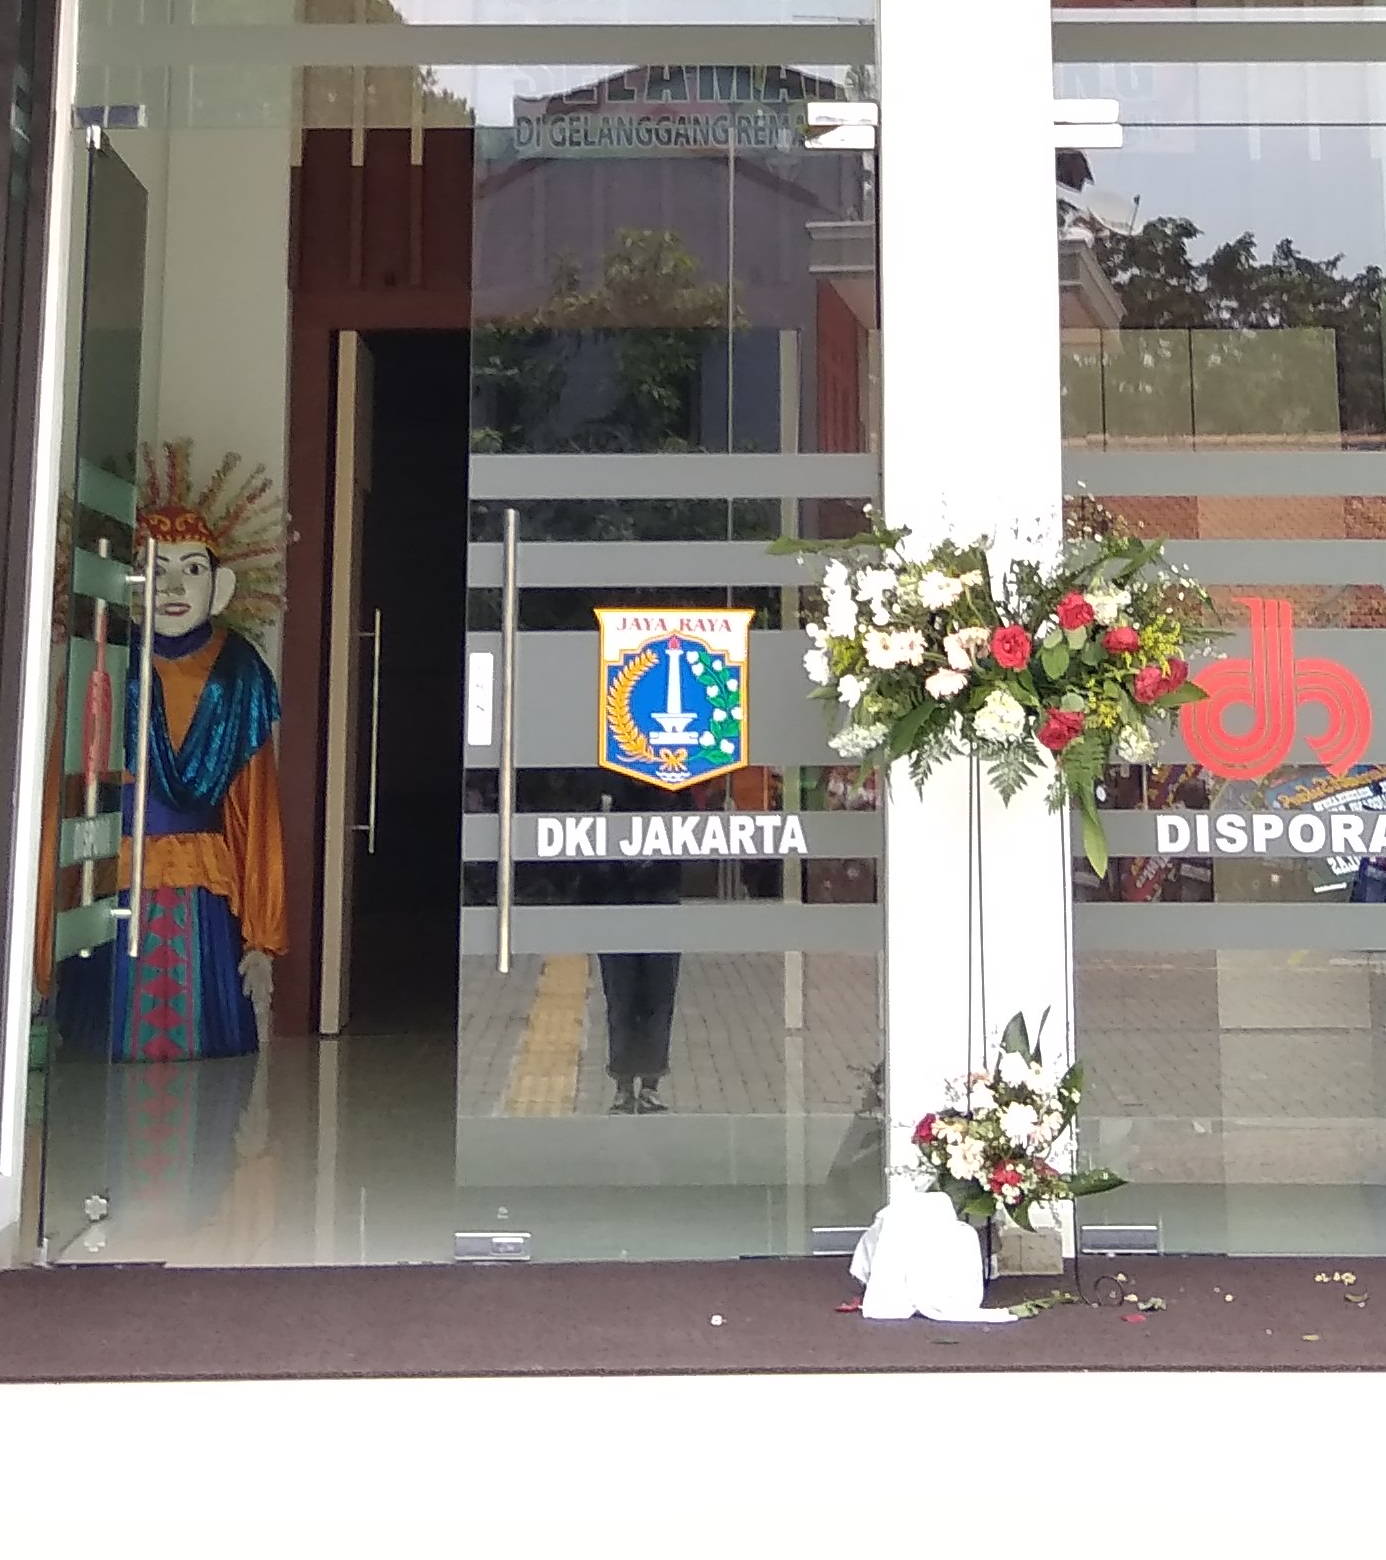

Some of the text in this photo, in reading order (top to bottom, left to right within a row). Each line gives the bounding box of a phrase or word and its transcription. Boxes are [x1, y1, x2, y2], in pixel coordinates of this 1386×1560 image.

[514, 114, 810, 148] DI GELANGGANG REMA
[616, 617, 732, 633] JAYA RAYA
[537, 815, 807, 856] DKI JAKARTA
